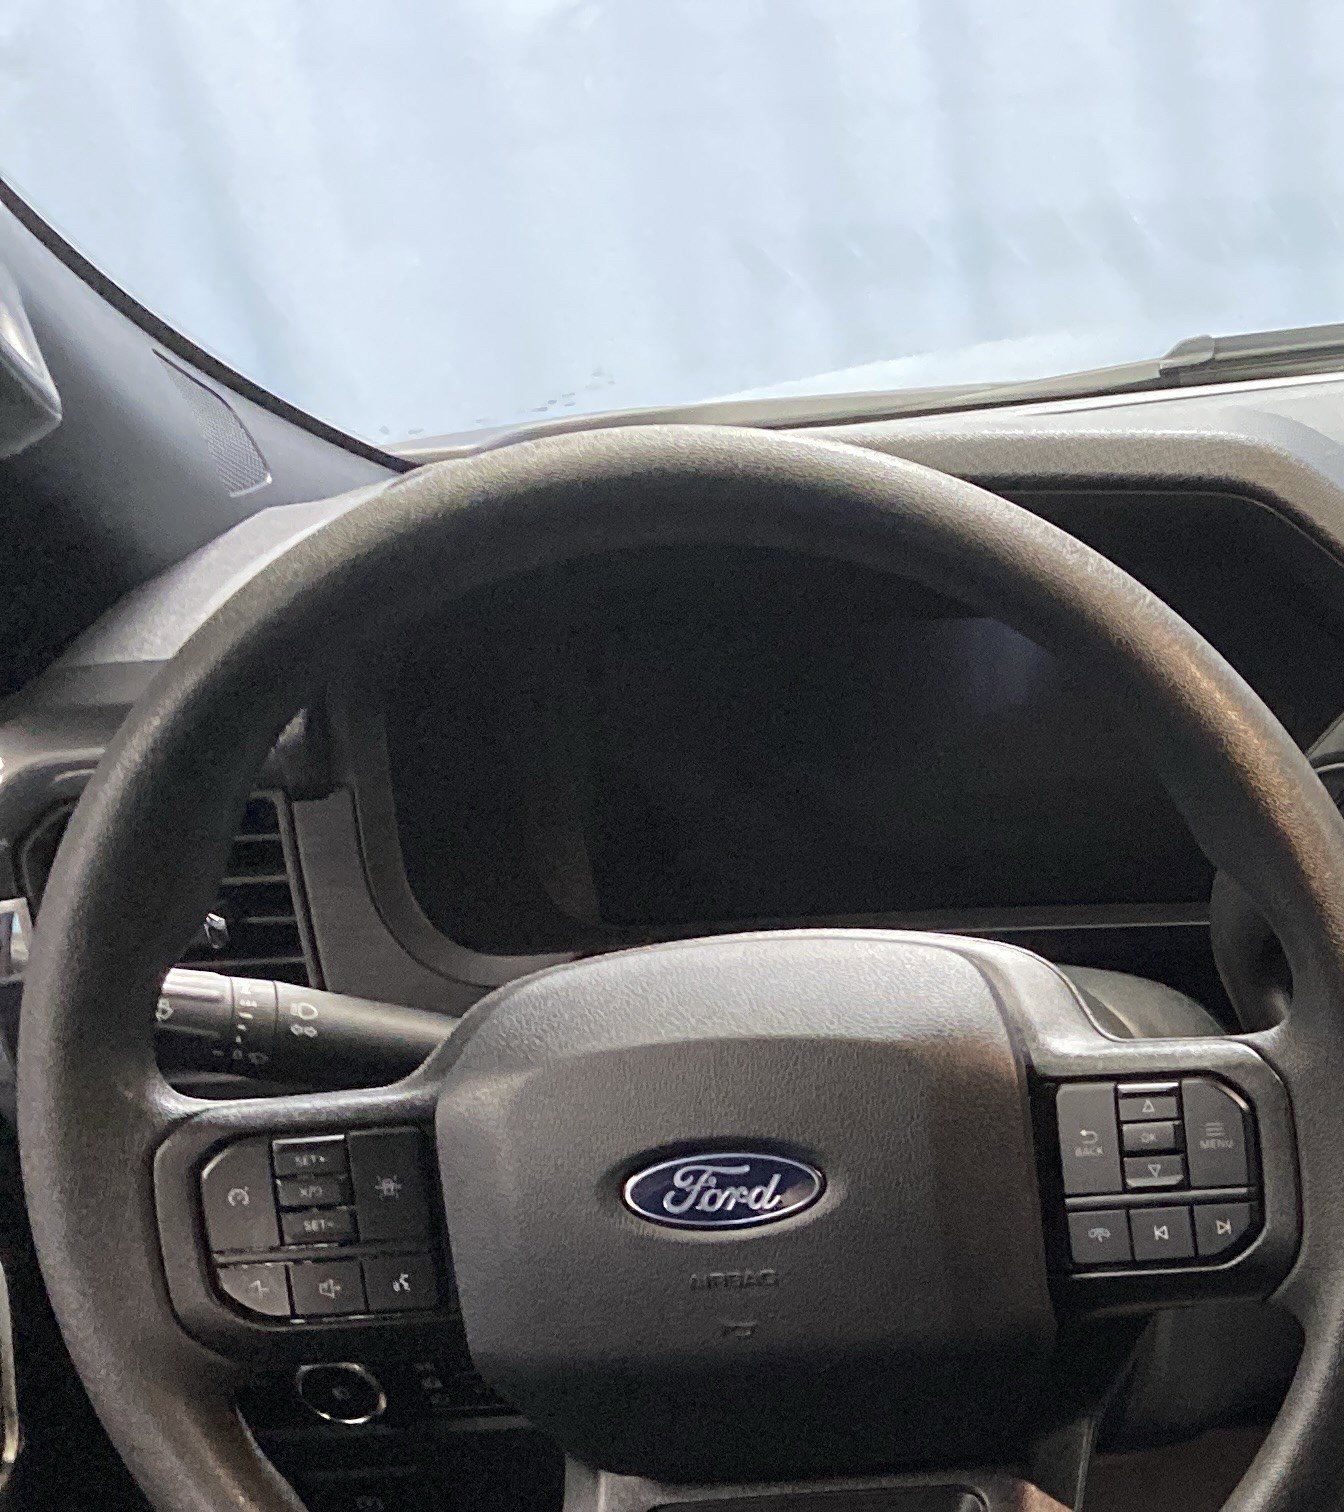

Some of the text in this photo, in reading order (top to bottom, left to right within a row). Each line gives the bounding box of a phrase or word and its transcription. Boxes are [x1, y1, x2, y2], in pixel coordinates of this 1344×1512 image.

[1200, 1139, 1235, 1150] MENU
[1075, 1146, 1103, 1157] BACK
[662, 1163, 782, 1215] Ford
